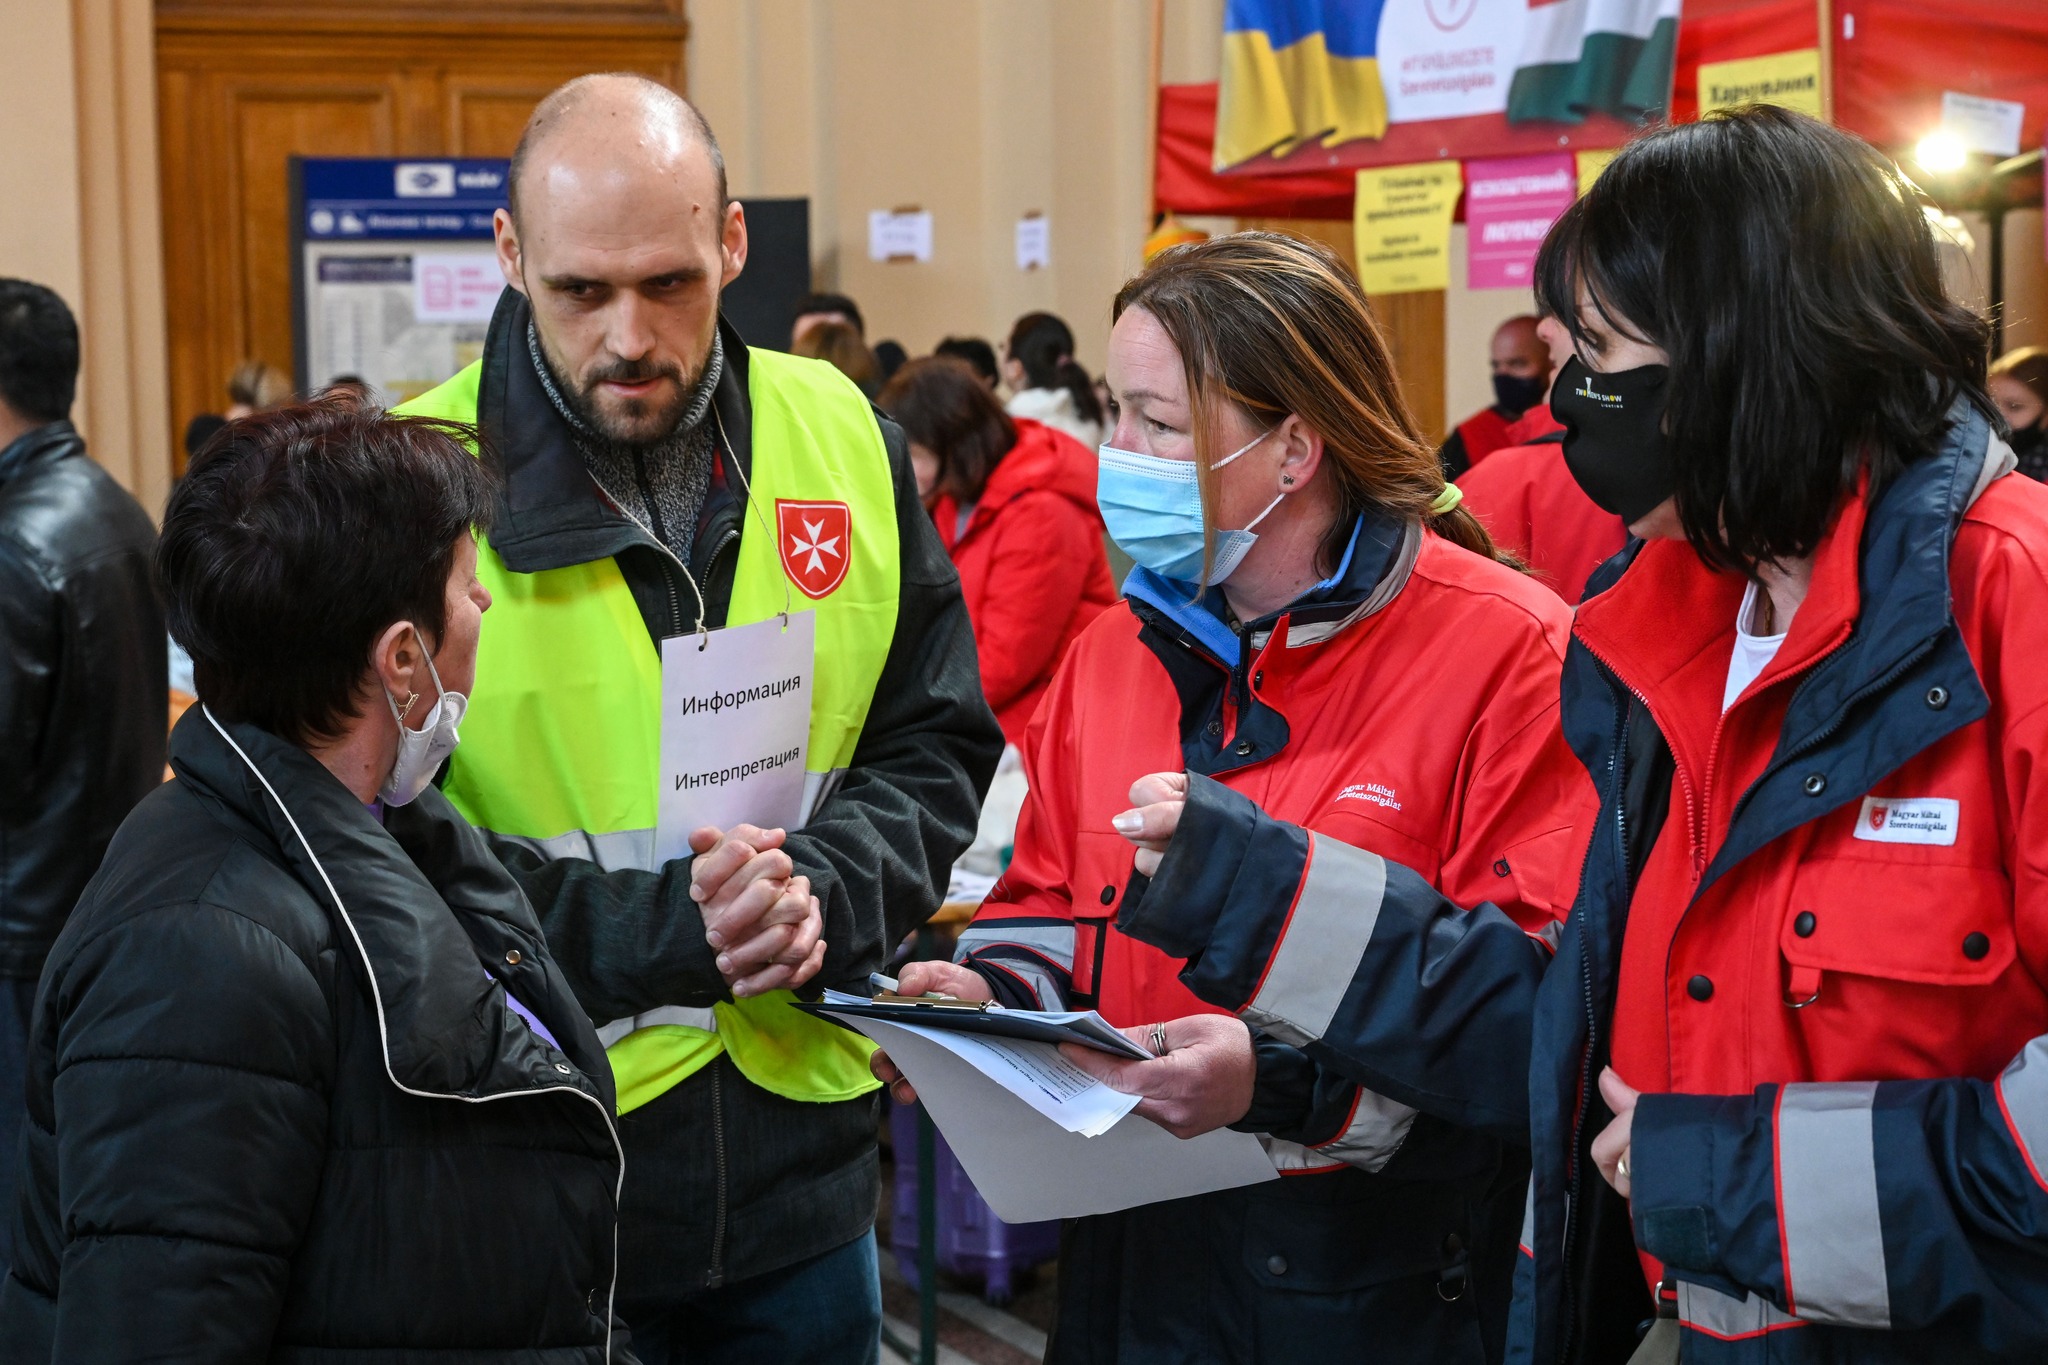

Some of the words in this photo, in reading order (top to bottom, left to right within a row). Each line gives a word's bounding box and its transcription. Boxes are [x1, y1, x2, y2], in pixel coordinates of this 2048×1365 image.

[1602, 394, 1622, 402] SHOW
[682, 675, 801, 716] Информация
[675, 747, 800, 791] Интерпретация
[1366, 783, 1396, 798] Máltai
[1891, 809, 1919, 820] Magyar
